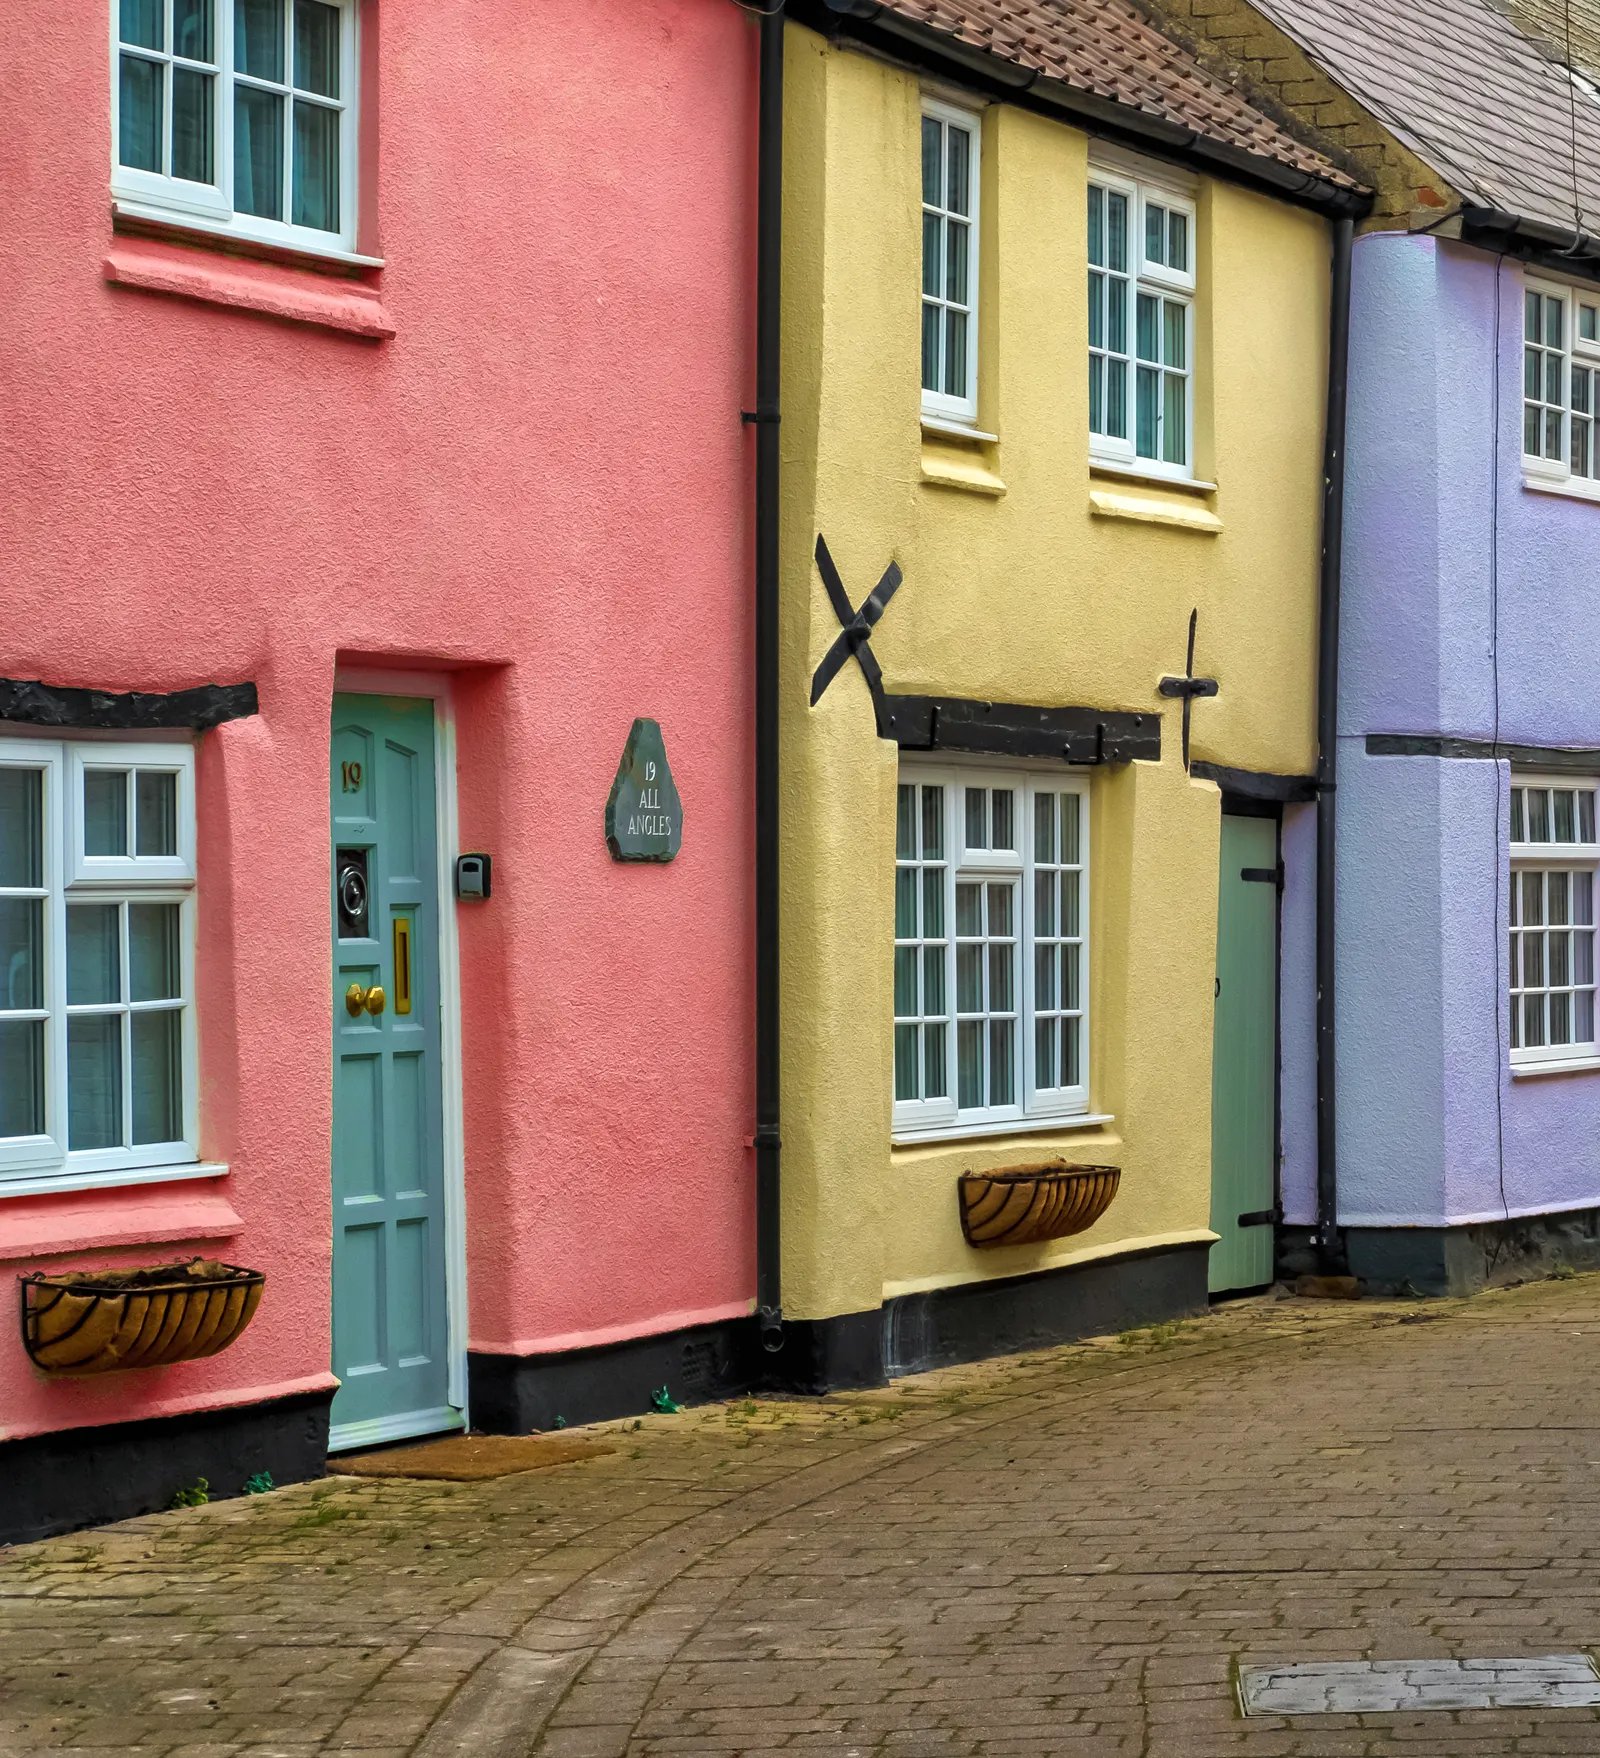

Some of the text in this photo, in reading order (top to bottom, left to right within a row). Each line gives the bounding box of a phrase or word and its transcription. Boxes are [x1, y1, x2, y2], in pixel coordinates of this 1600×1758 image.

[342, 761, 362, 793] 19
[644, 761, 656, 781] 19
[639, 788, 661, 809] ALL
[627, 814, 672, 836] ANGLES
